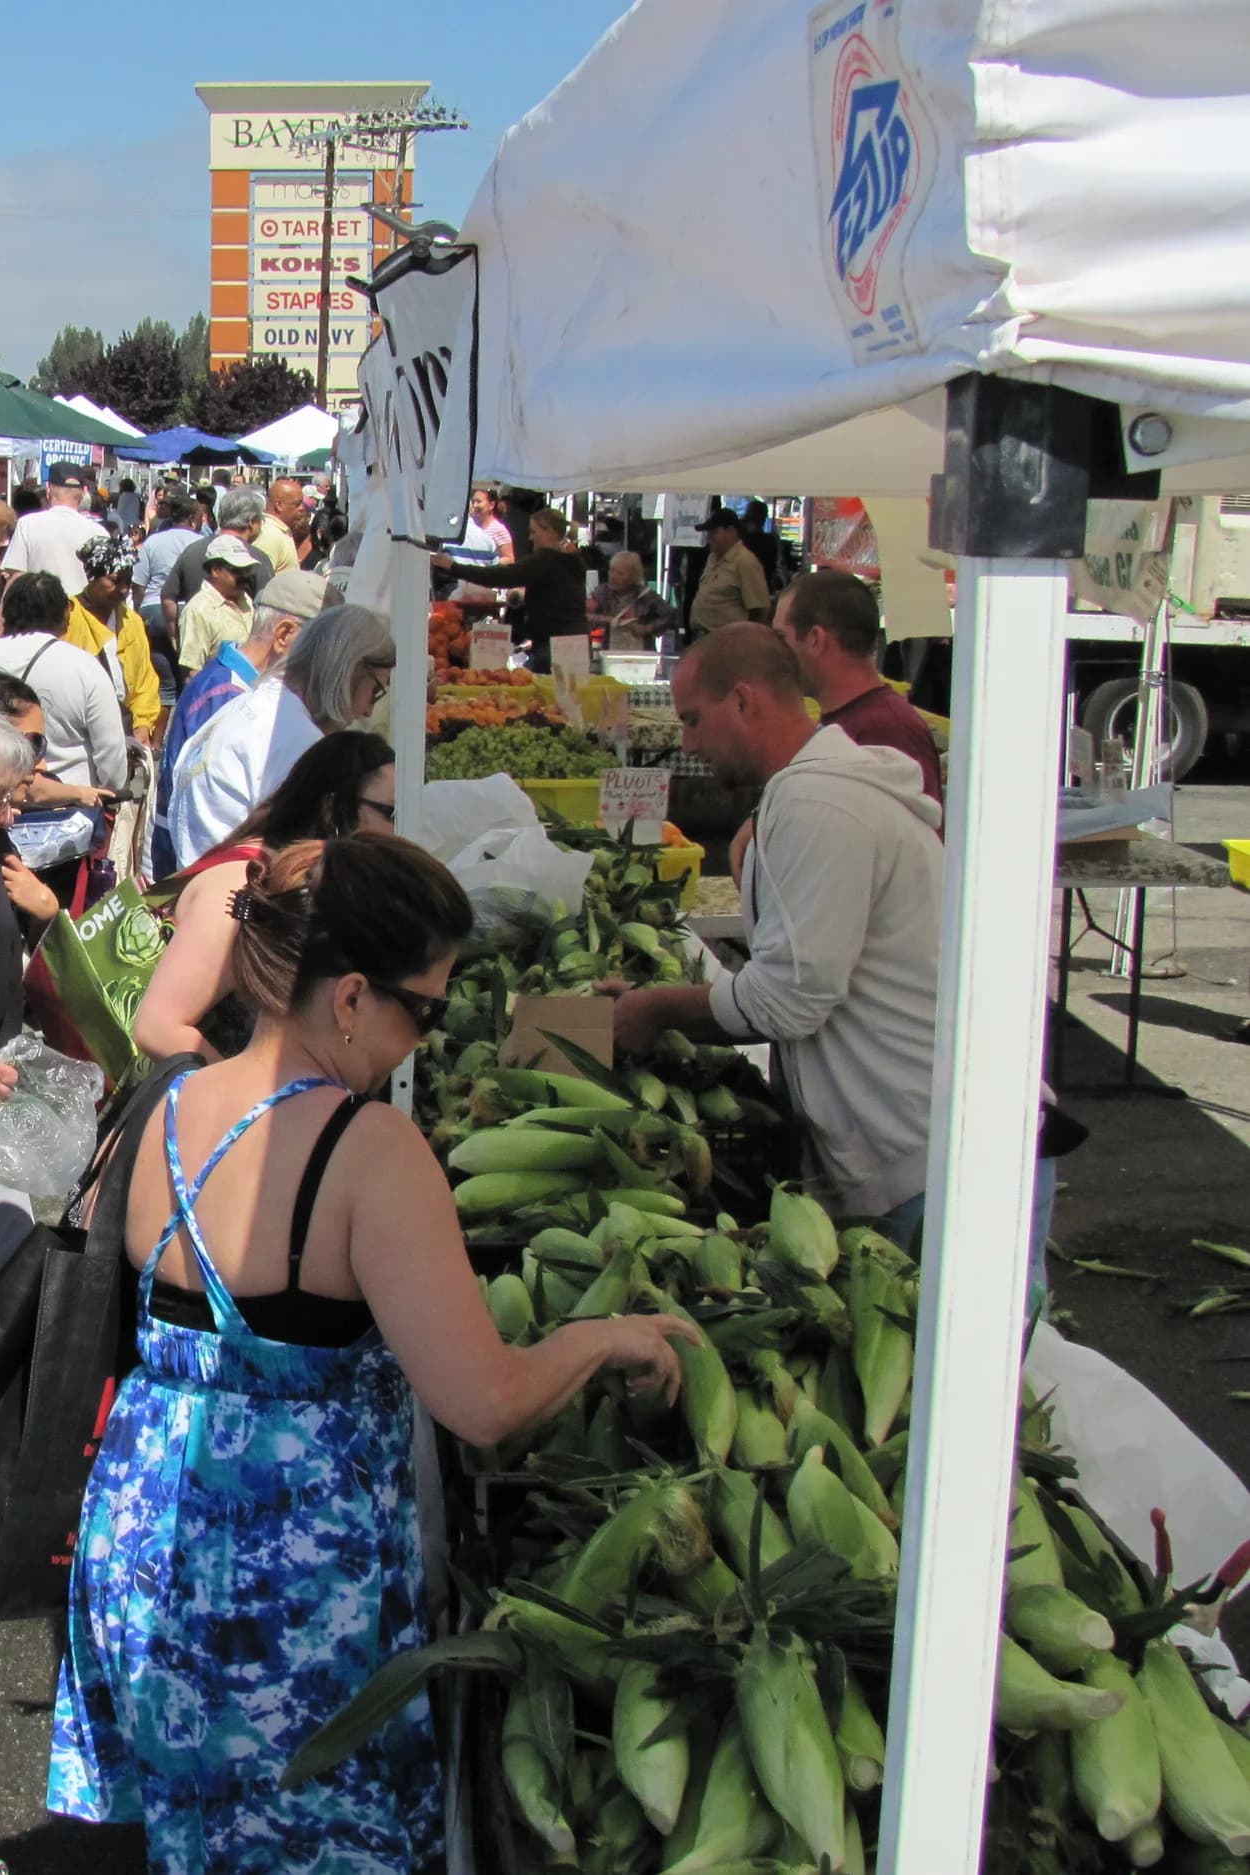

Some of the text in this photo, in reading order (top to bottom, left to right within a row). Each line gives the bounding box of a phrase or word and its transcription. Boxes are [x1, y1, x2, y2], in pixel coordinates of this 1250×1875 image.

[264, 328, 354, 346] OLD NVY
[43, 439, 90, 455] CERTIFIED
